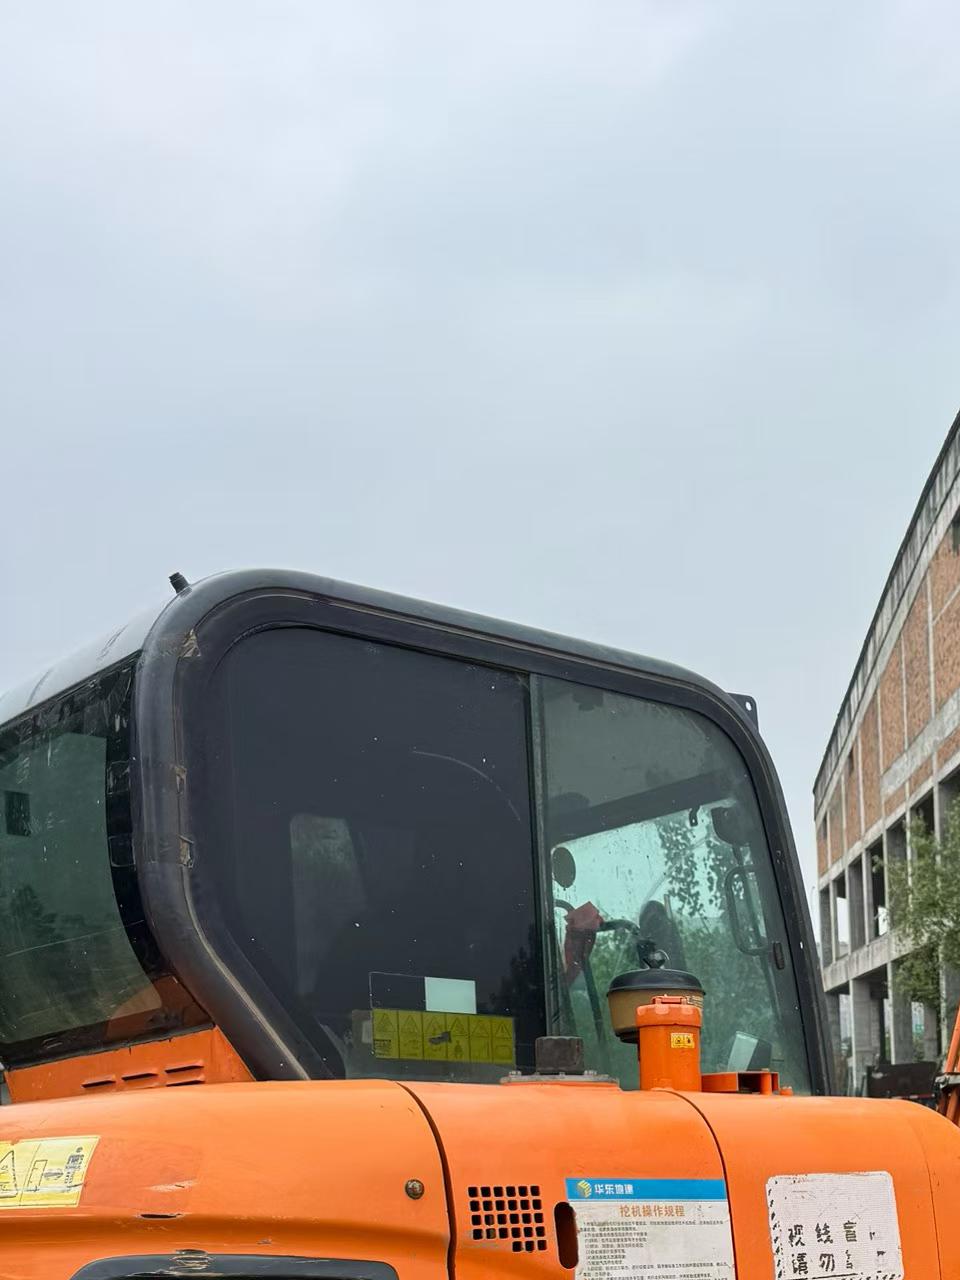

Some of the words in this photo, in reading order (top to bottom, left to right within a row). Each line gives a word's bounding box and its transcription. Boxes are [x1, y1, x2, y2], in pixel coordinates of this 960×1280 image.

[619, 1204, 686, 1218] 挖机操作规程
[787, 1220, 877, 1247] 视线盲
[791, 1249, 886, 1275] 请勿
